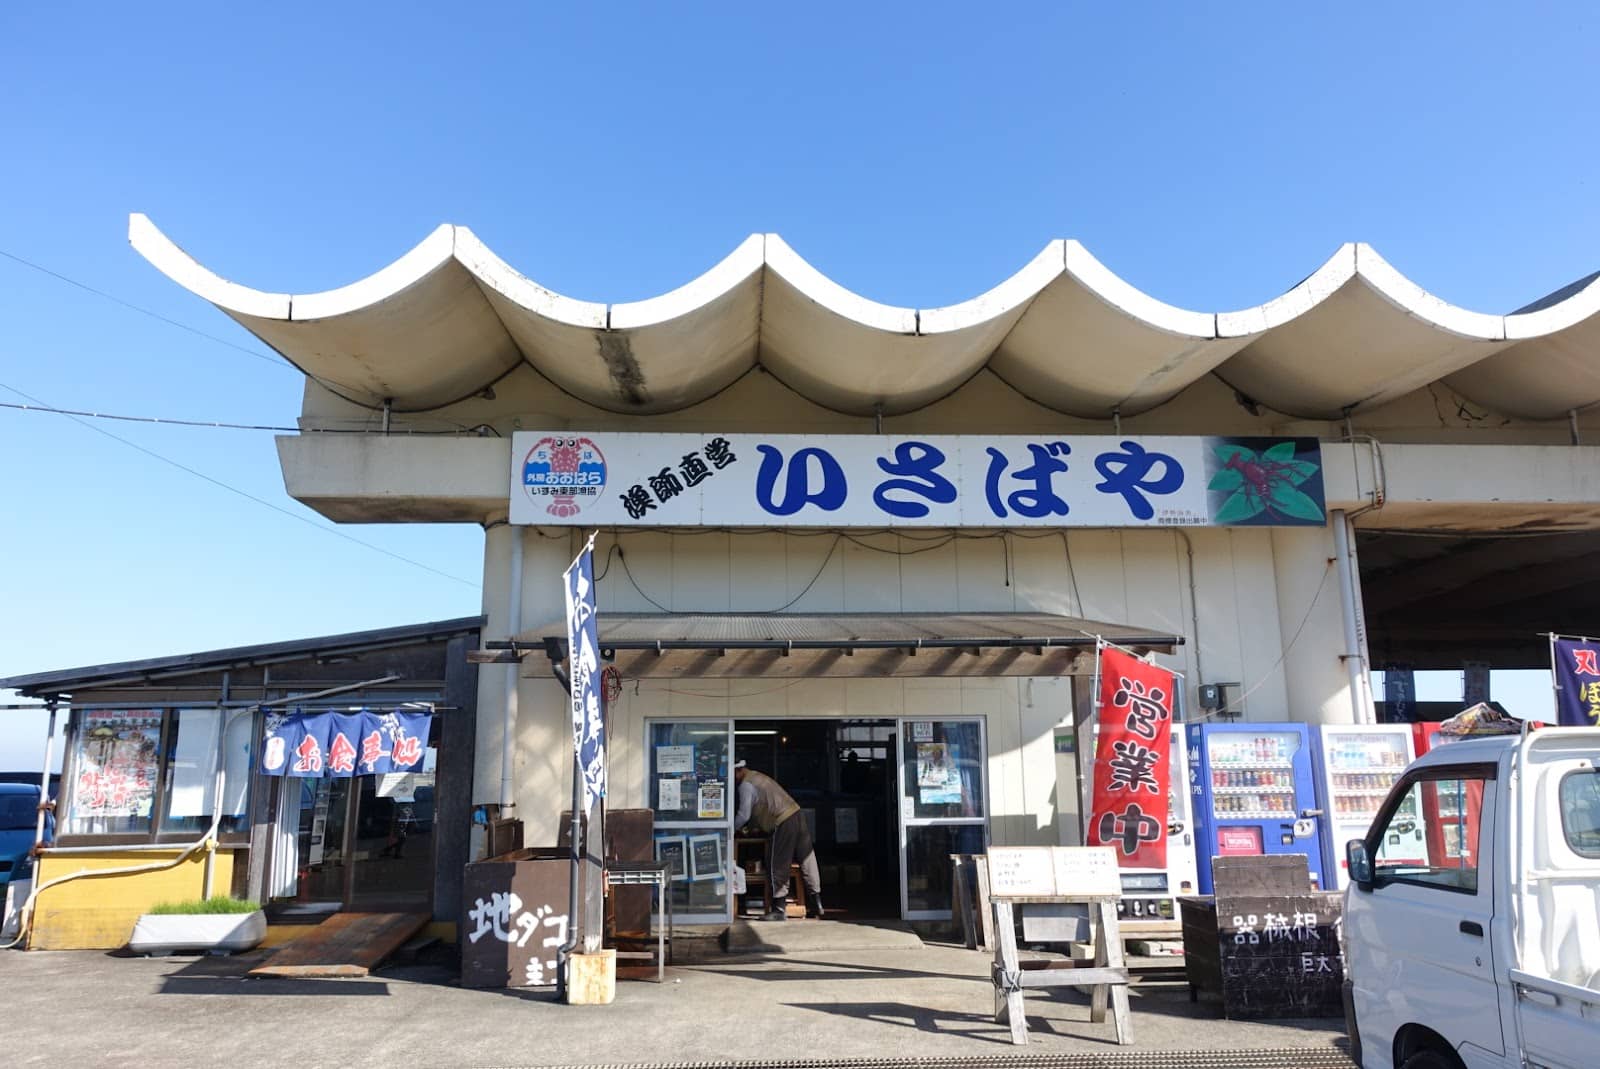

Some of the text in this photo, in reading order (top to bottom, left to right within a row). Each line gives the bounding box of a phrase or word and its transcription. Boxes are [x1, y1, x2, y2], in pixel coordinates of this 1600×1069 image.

[619, 437, 737, 520] 漁師直営
[756, 440, 1185, 521] いさばや
[293, 730, 422, 773] お食事処
[1098, 676, 1168, 856] 営業中
